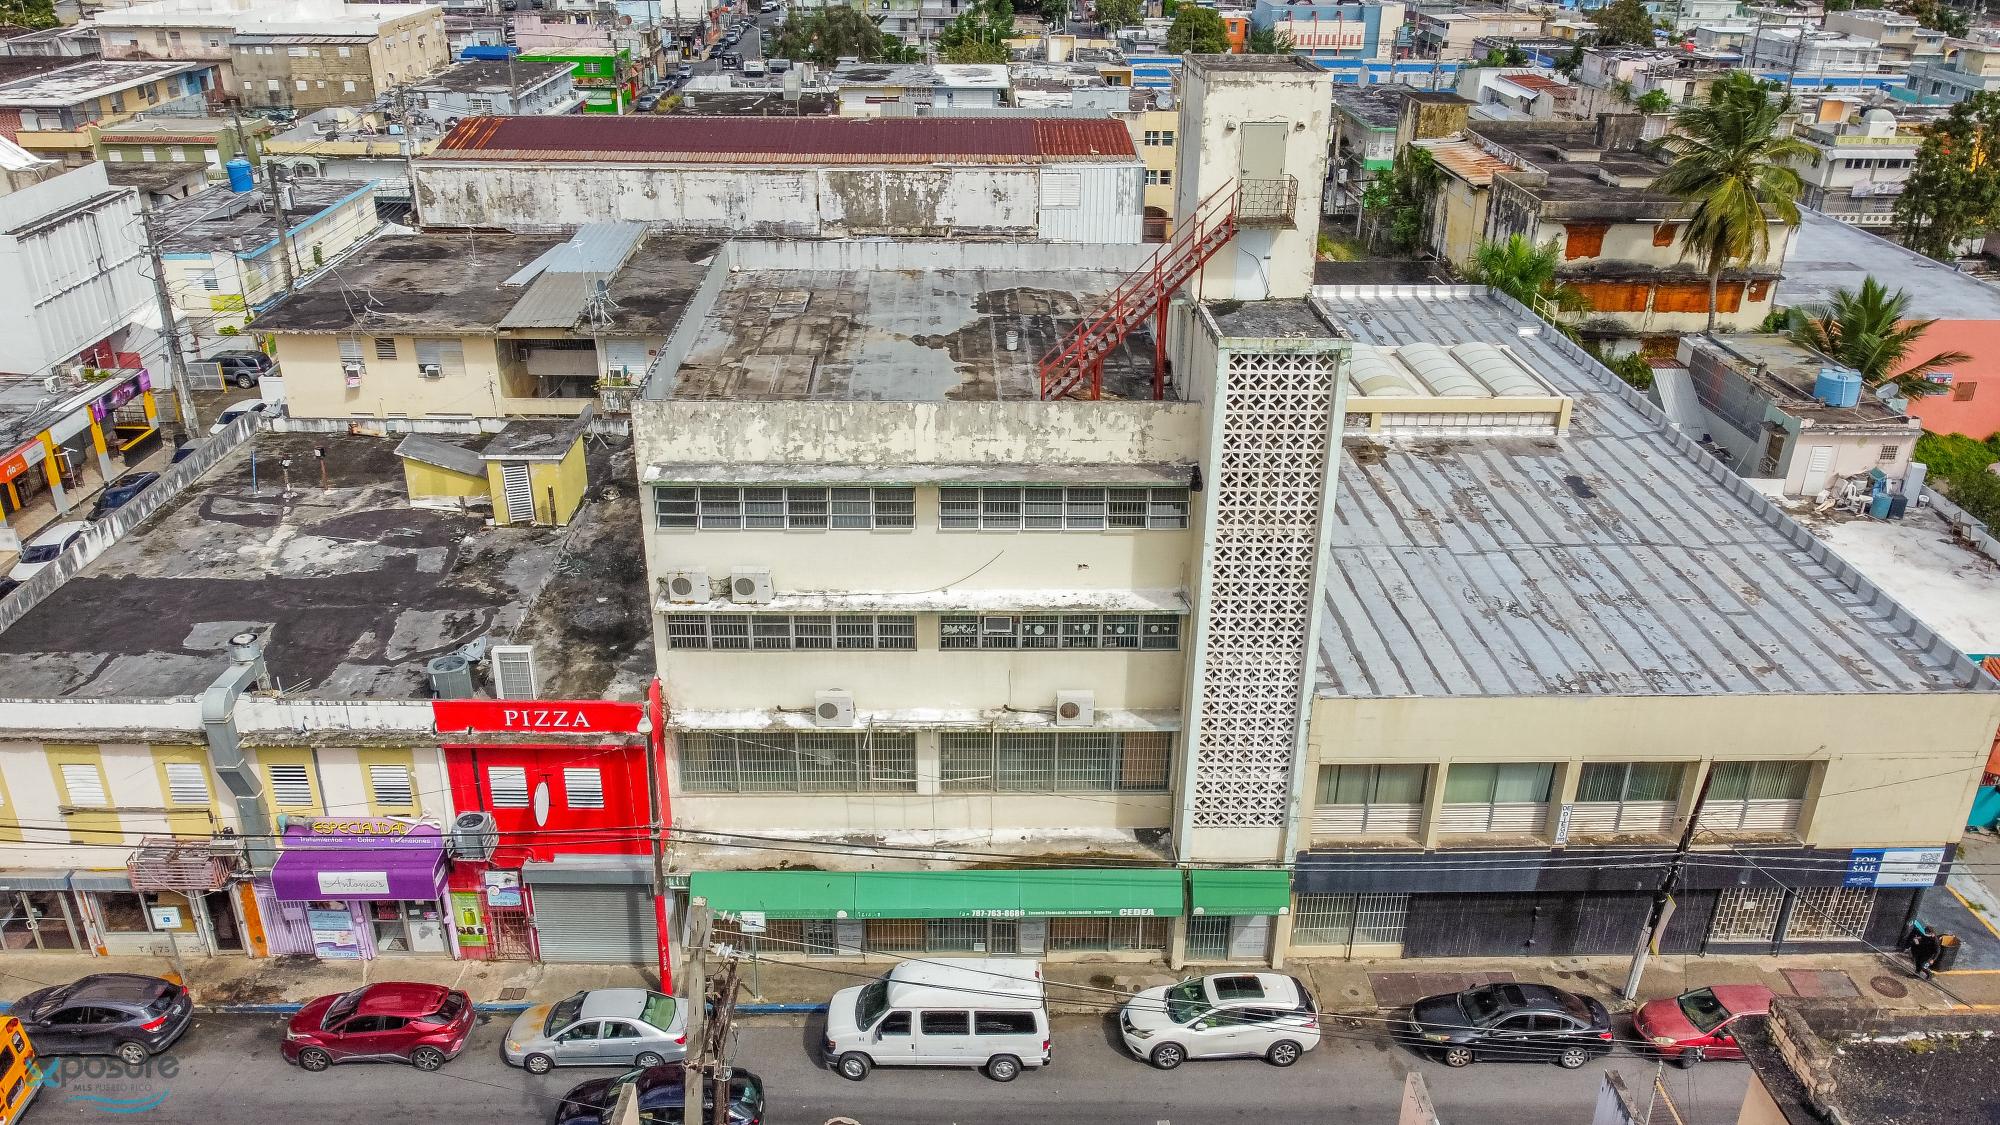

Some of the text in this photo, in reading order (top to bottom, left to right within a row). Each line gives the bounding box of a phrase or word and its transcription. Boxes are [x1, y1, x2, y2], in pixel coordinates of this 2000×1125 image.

[503, 709, 591, 728] PIZZA
[311, 821, 410, 835] ESPECIALIDAD
[1855, 857, 1877, 865] FOR
[1852, 865, 1877, 873] SALE
[1118, 908, 1155, 917] CEDEA
